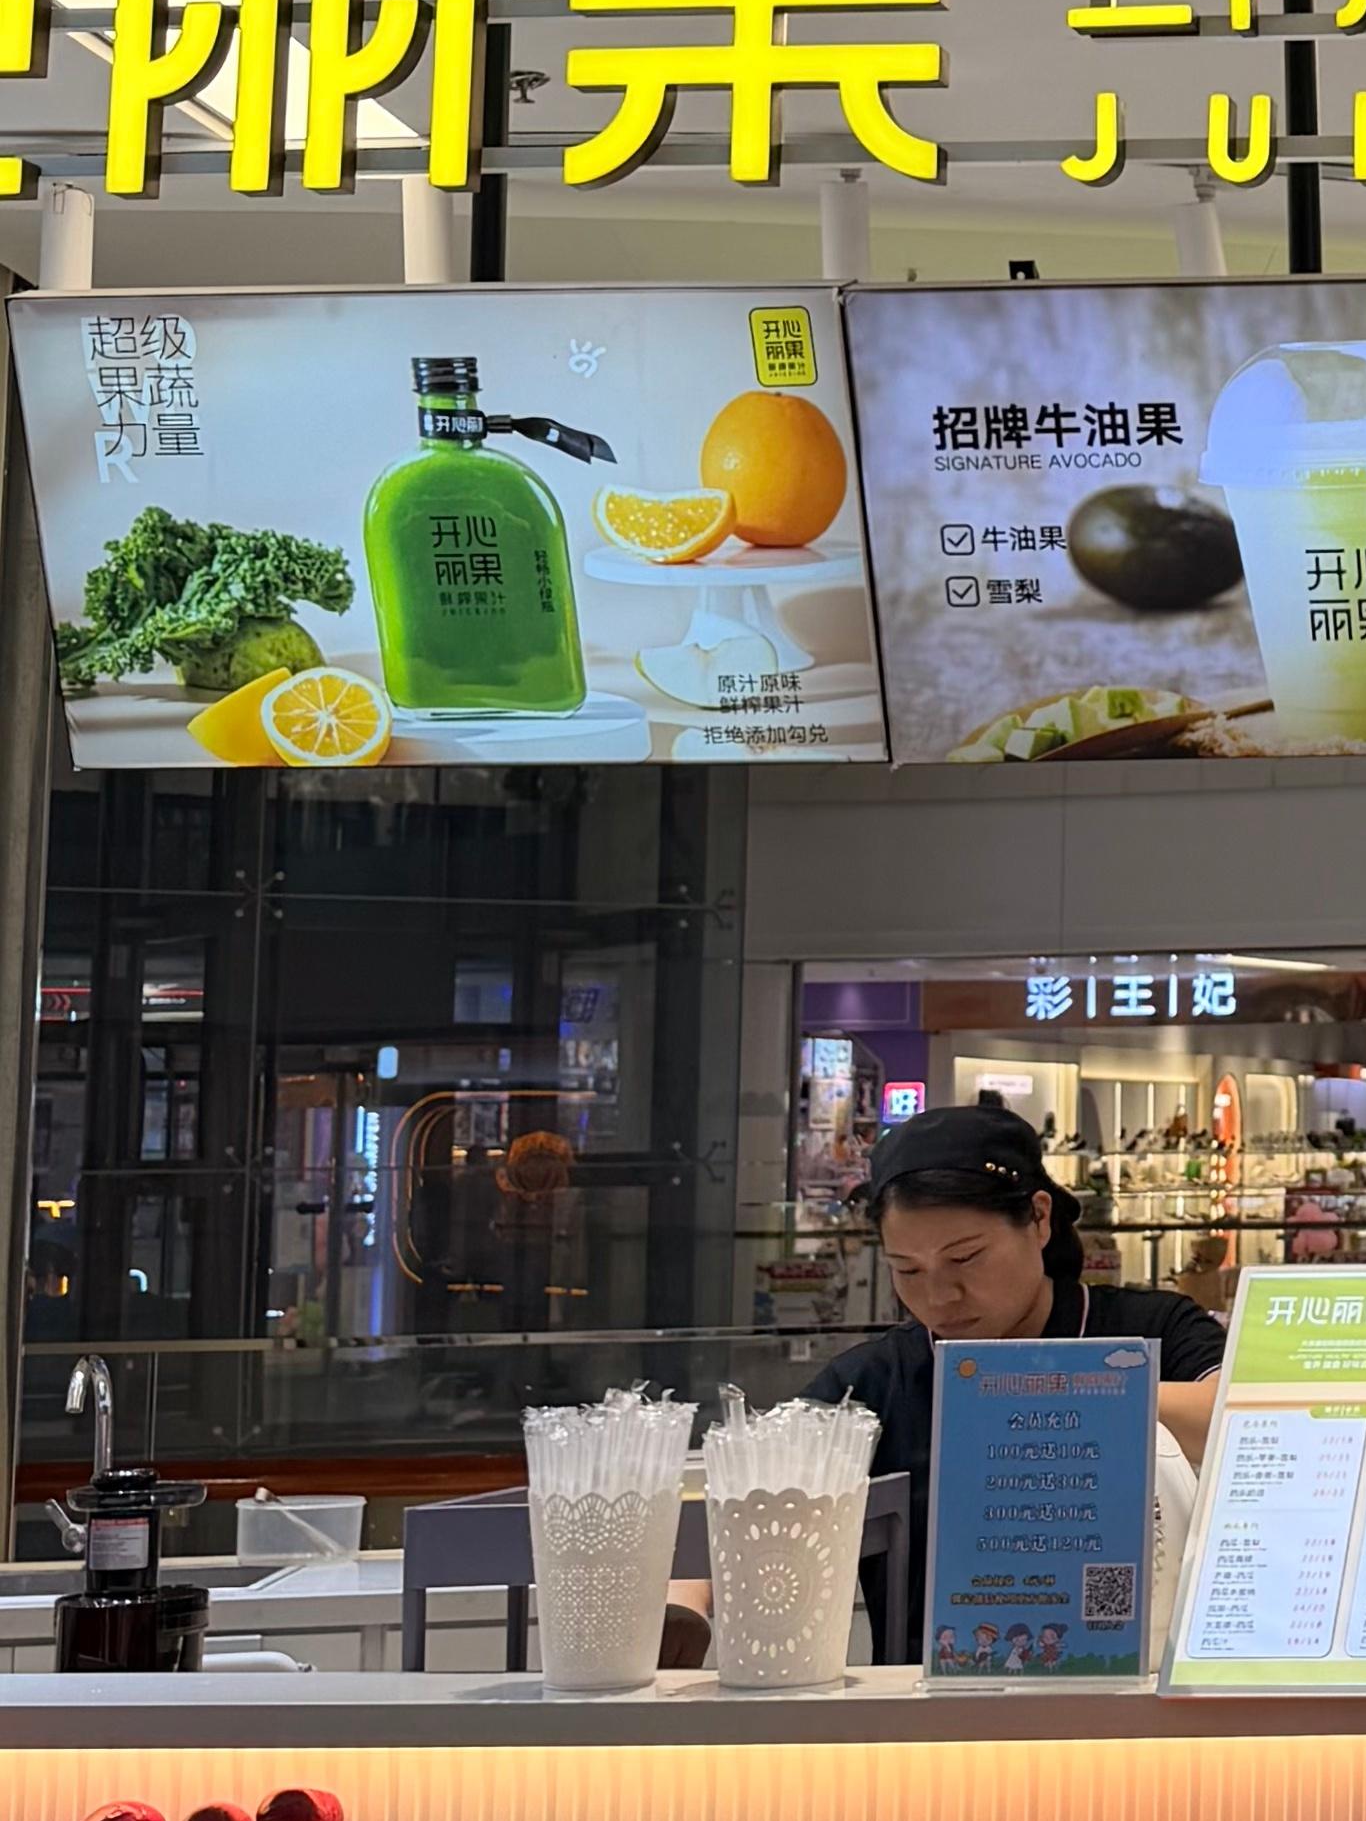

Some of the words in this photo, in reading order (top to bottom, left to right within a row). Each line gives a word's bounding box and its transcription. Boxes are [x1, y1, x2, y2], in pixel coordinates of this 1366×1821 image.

[88, 315, 192, 360] 超级
[762, 320, 802, 339] 开心
[765, 340, 805, 360] 丽果
[97, 364, 200, 409] 果蔬
[102, 414, 204, 457] 力量
[933, 402, 1183, 451] 招牌牛油果
[935, 455, 1042, 471] SIGNATURE
[1049, 452, 1142, 469] AVOCADO
[429, 516, 498, 548] 开心
[981, 525, 1067, 552] 牛油果
[434, 553, 504, 585] 丽果
[986, 578, 1043, 604] 雪梨
[717, 673, 802, 693] 原汁原味
[719, 694, 804, 714] 鲜榨果汁
[704, 724, 828, 745] 拒绝添加勾兑
